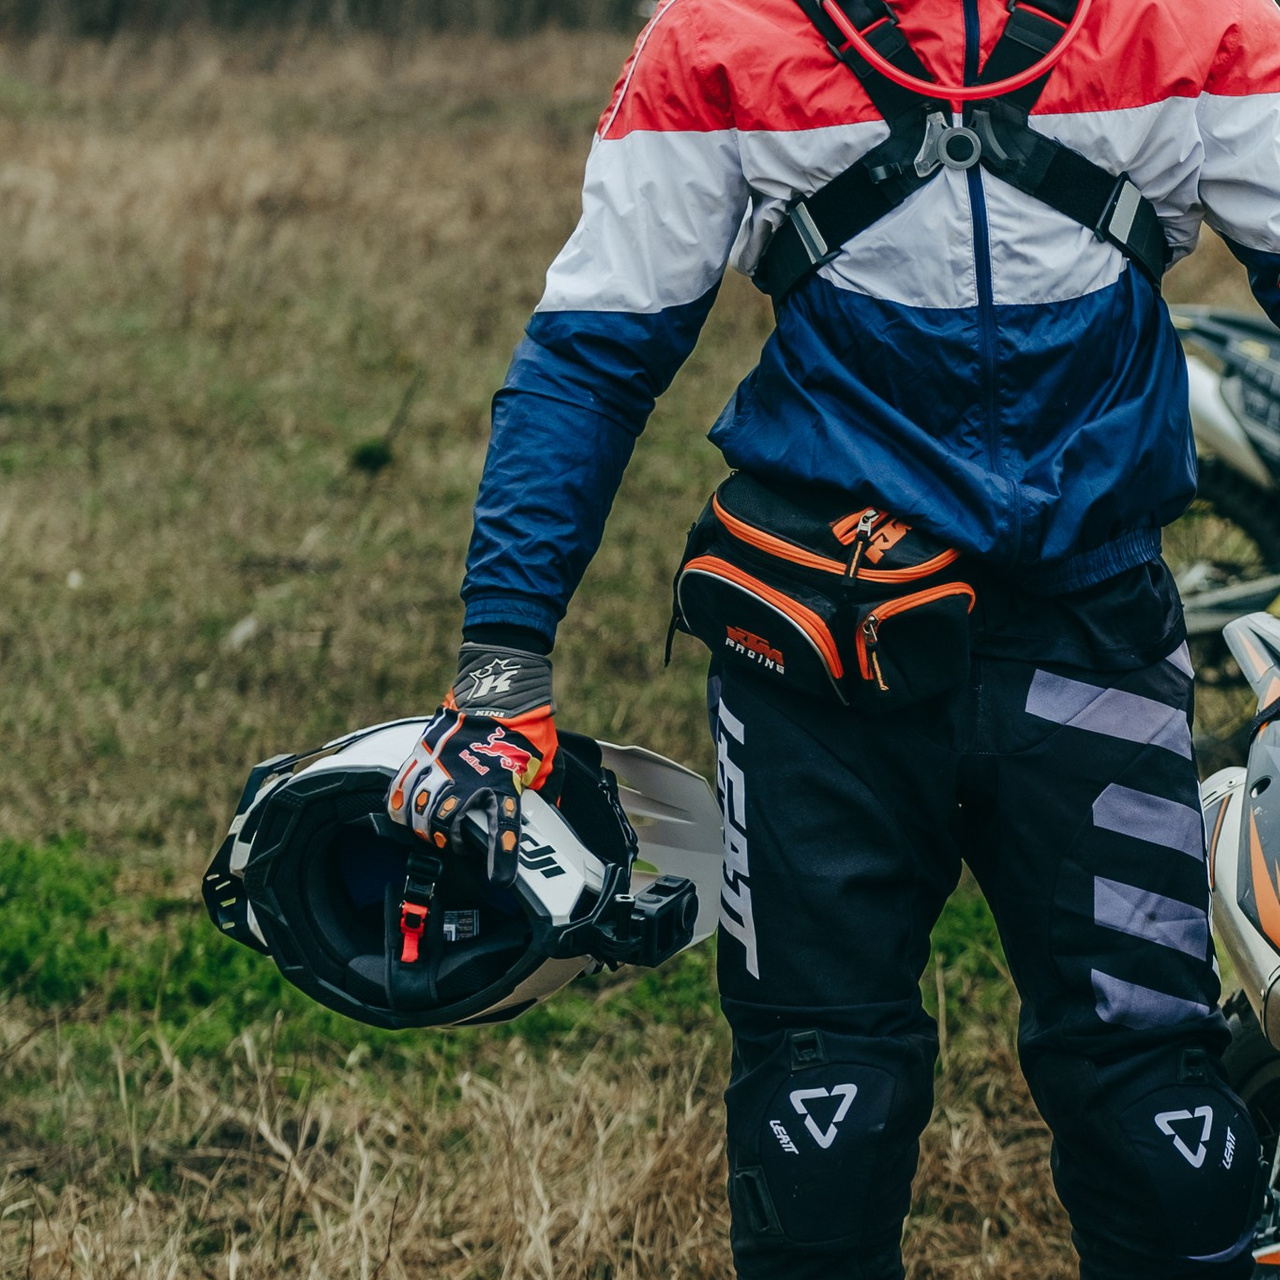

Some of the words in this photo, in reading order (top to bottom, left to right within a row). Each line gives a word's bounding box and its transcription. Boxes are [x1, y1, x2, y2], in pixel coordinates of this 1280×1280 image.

[725, 637, 785, 675] RACING
[726, 625, 784, 665] KTM
[474, 710, 505, 718] KINI
[717, 696, 760, 980] LEATT
[769, 1119, 800, 1155] LEATT
[1222, 1125, 1237, 1170] LEATT
